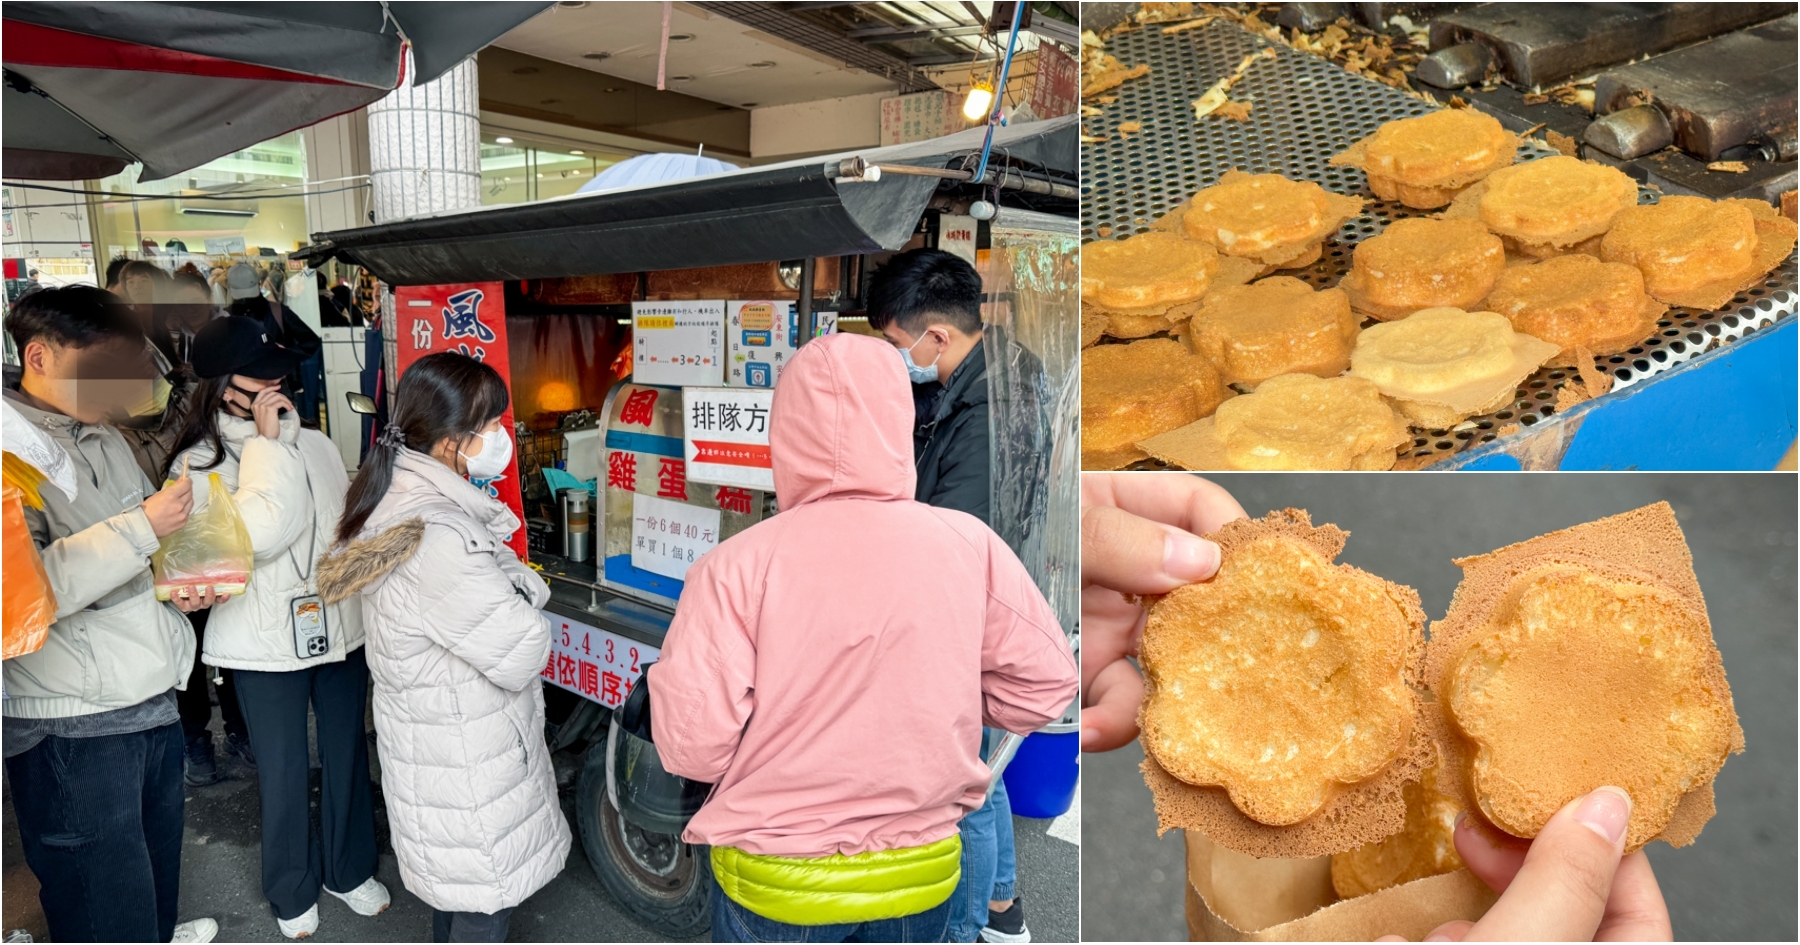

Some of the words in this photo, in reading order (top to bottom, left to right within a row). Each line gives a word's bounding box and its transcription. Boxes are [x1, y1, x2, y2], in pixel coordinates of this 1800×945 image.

[407, 300, 434, 350] 一份
[442, 290, 496, 362] 風
[680, 354, 686, 366] 3
[694, 355, 701, 366] 2
[620, 389, 659, 427] 風
[692, 401, 768, 432] 排隊方
[636, 536, 706, 563] 單買1個8
